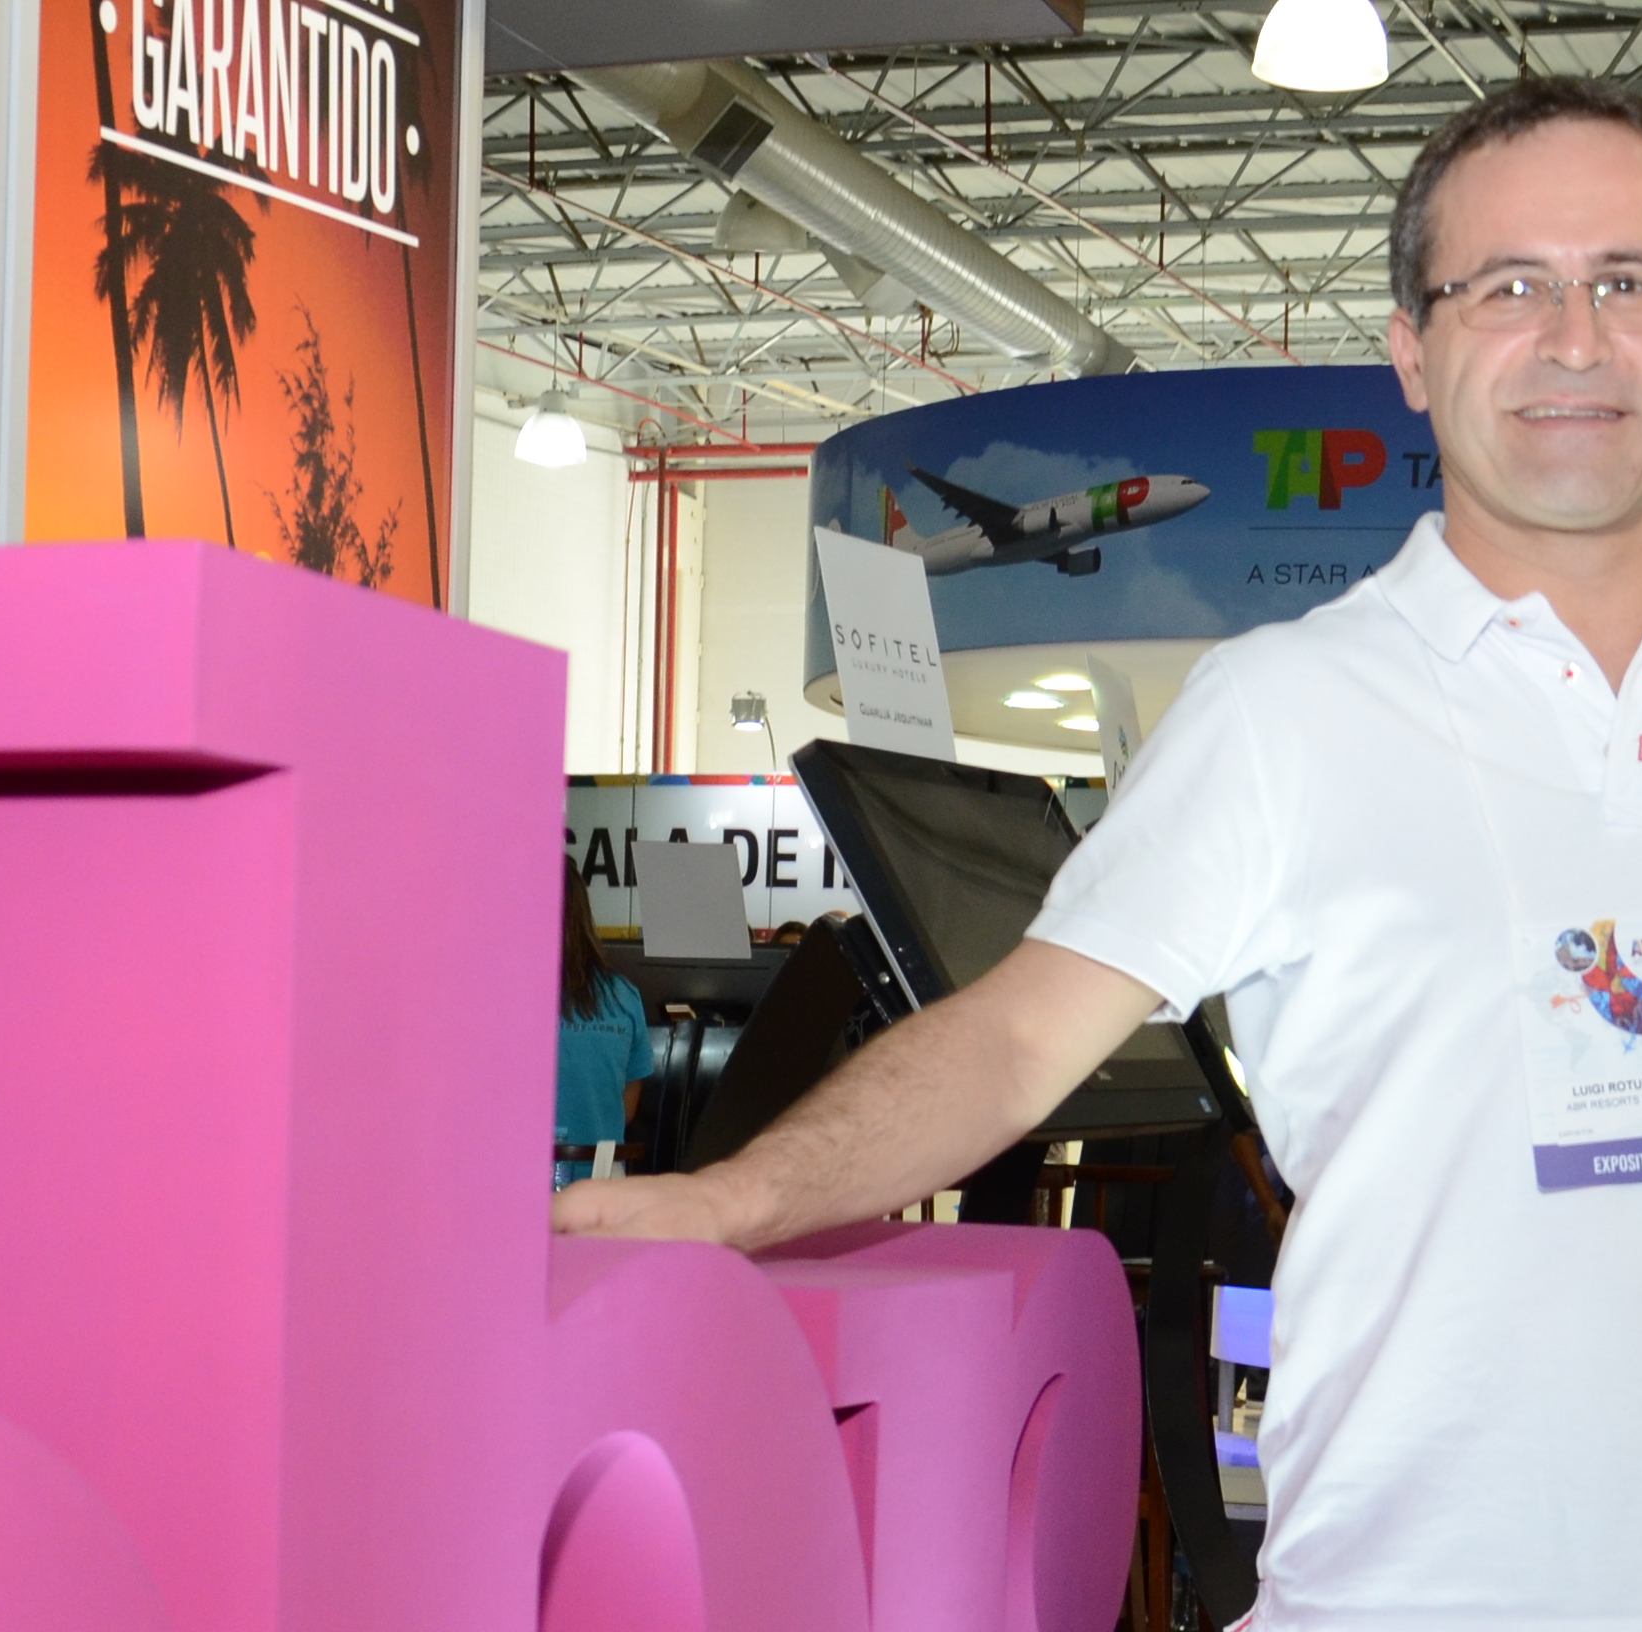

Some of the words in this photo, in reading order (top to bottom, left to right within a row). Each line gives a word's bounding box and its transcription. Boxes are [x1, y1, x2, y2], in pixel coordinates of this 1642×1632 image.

[131, 0, 397, 214] GARANTIDO
[1253, 429, 1388, 510] TAP
[1247, 565, 1264, 584] A
[1274, 563, 1347, 585] STAR
[835, 624, 937, 667] SOFITEL
[1572, 1086, 1605, 1097] LUIGI
[1591, 1095, 1640, 1109] RESORTS
